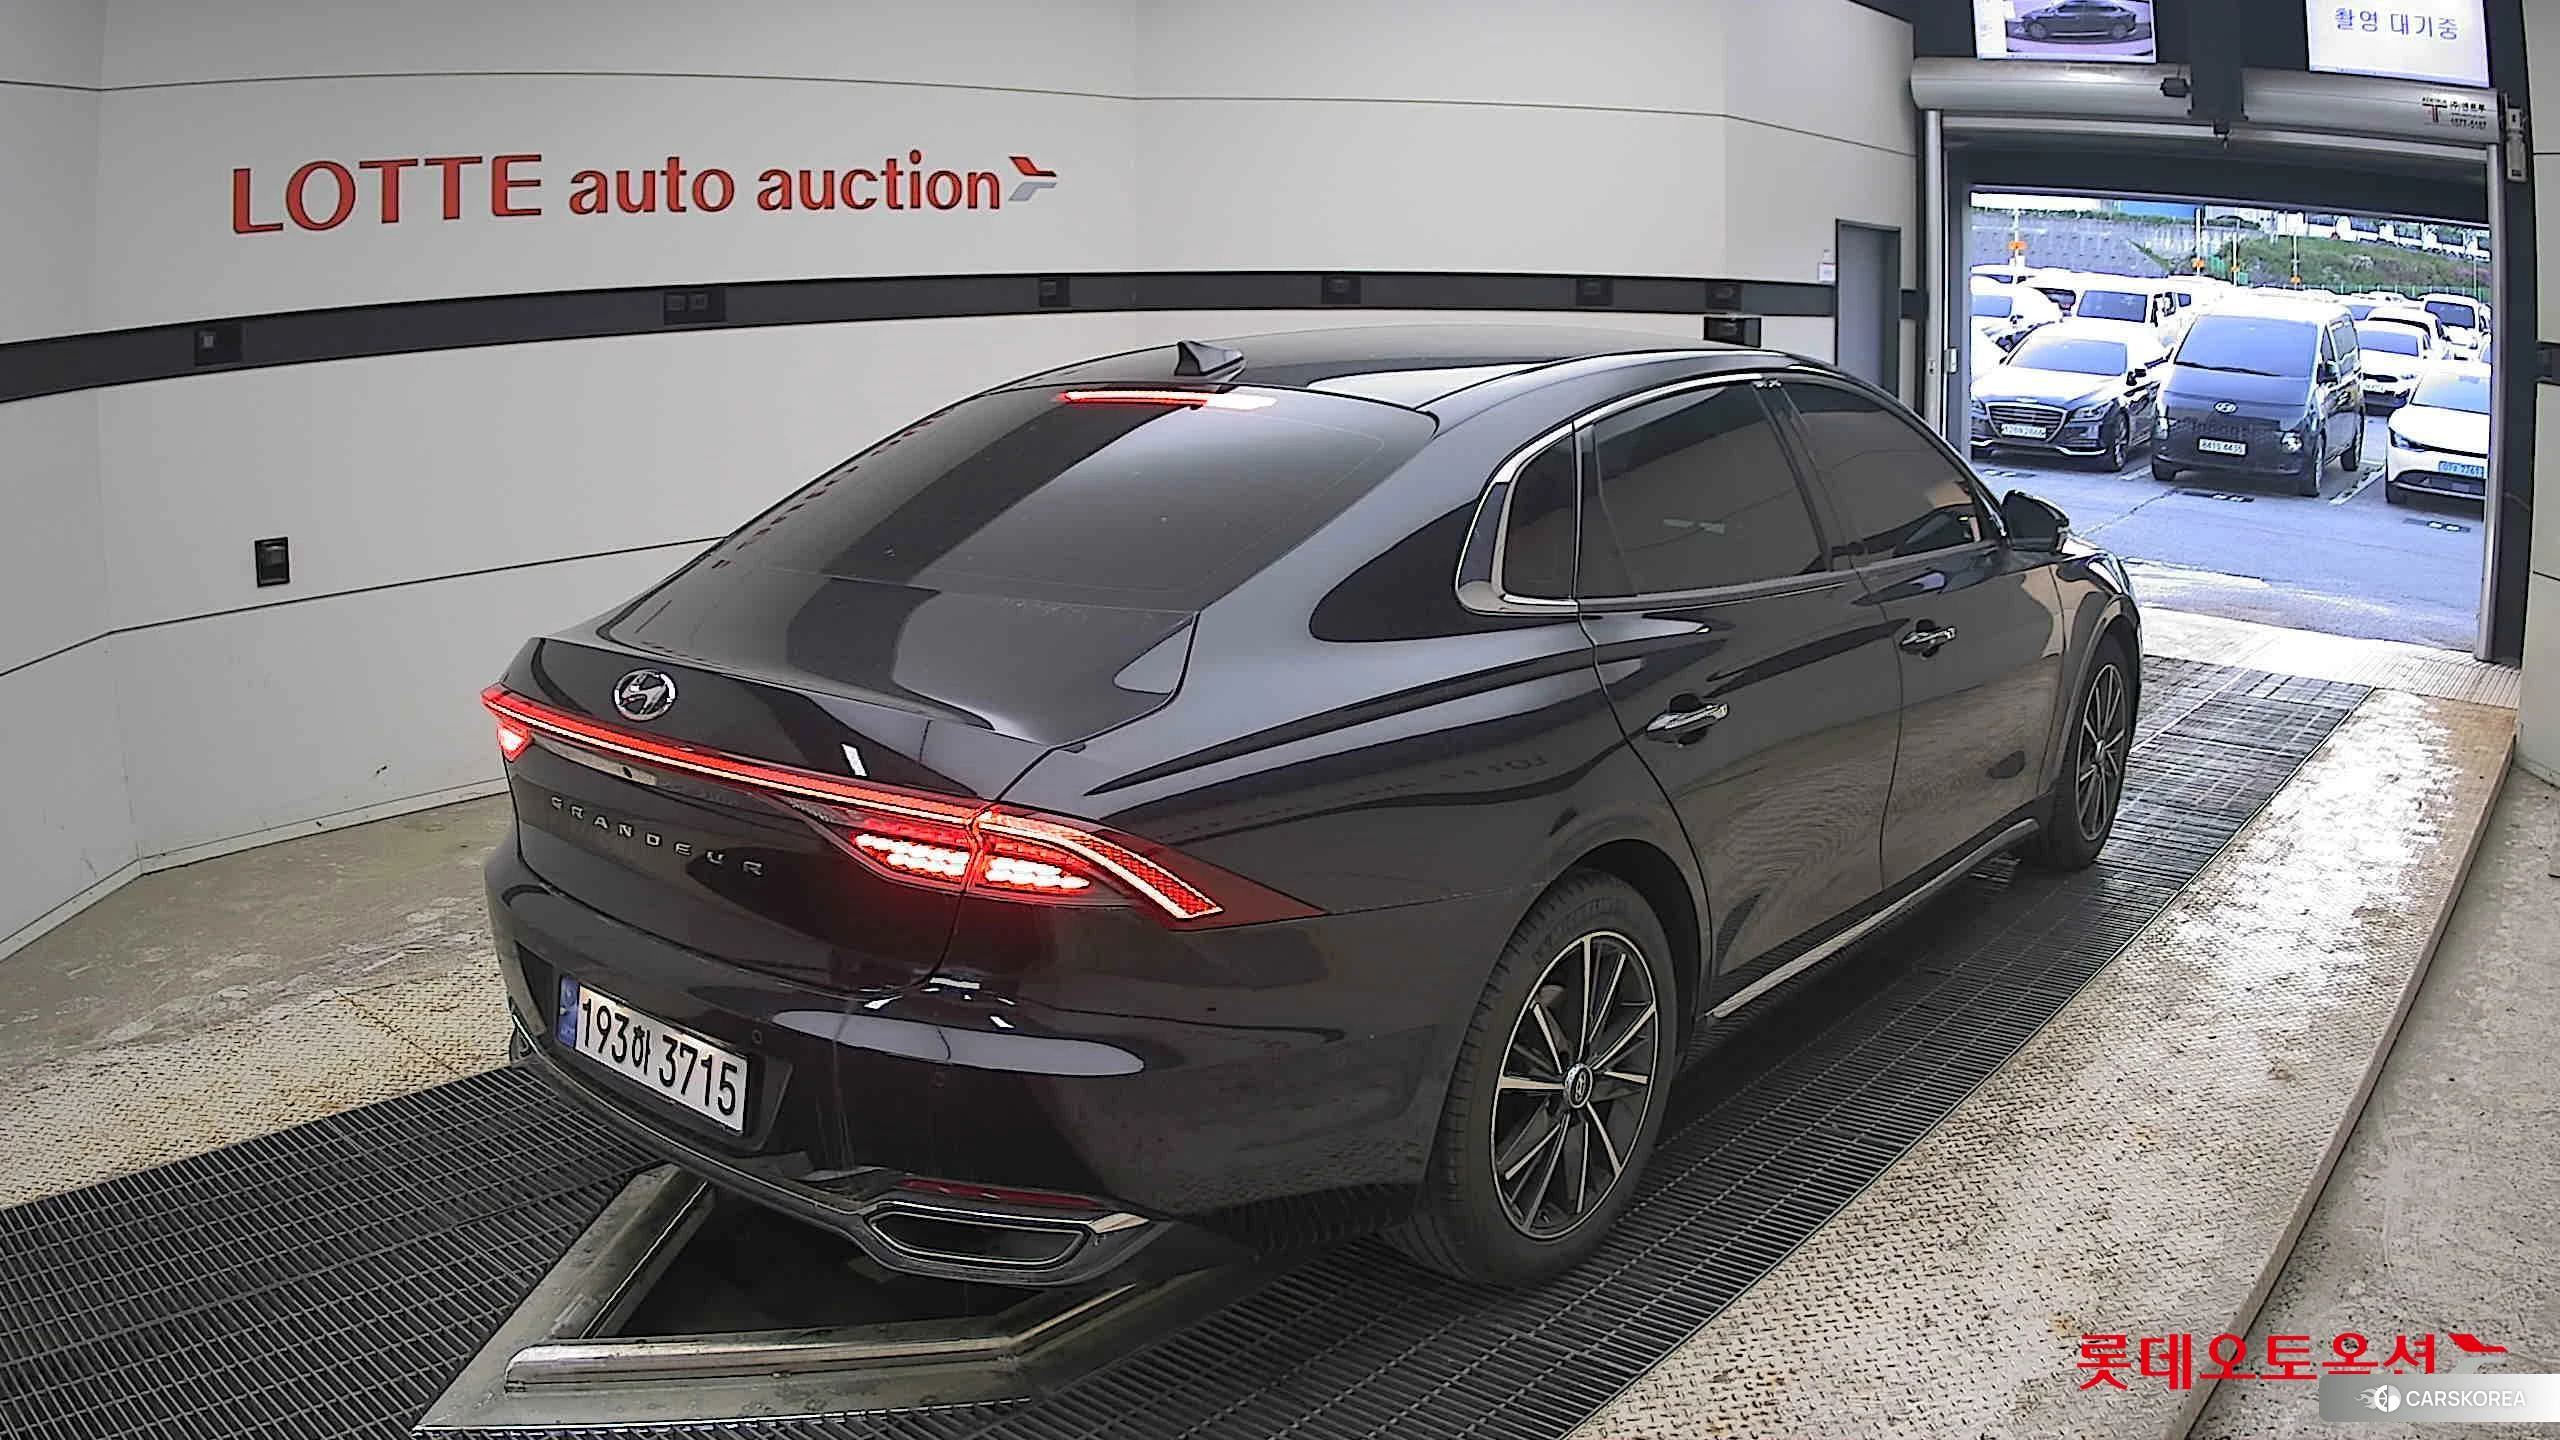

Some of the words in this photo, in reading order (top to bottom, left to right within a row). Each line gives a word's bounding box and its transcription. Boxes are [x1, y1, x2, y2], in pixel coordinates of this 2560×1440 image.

[2335, 7, 2379, 33] 촬영
[2390, 13, 2459, 41] 대기중
[233, 154, 543, 234] LOTTE
[568, 155, 735, 215] auto
[756, 149, 1001, 211] auction
[551, 796, 764, 876] GRANDEUR
[582, 998, 651, 1075] 193하
[659, 1034, 739, 1116] 3715
